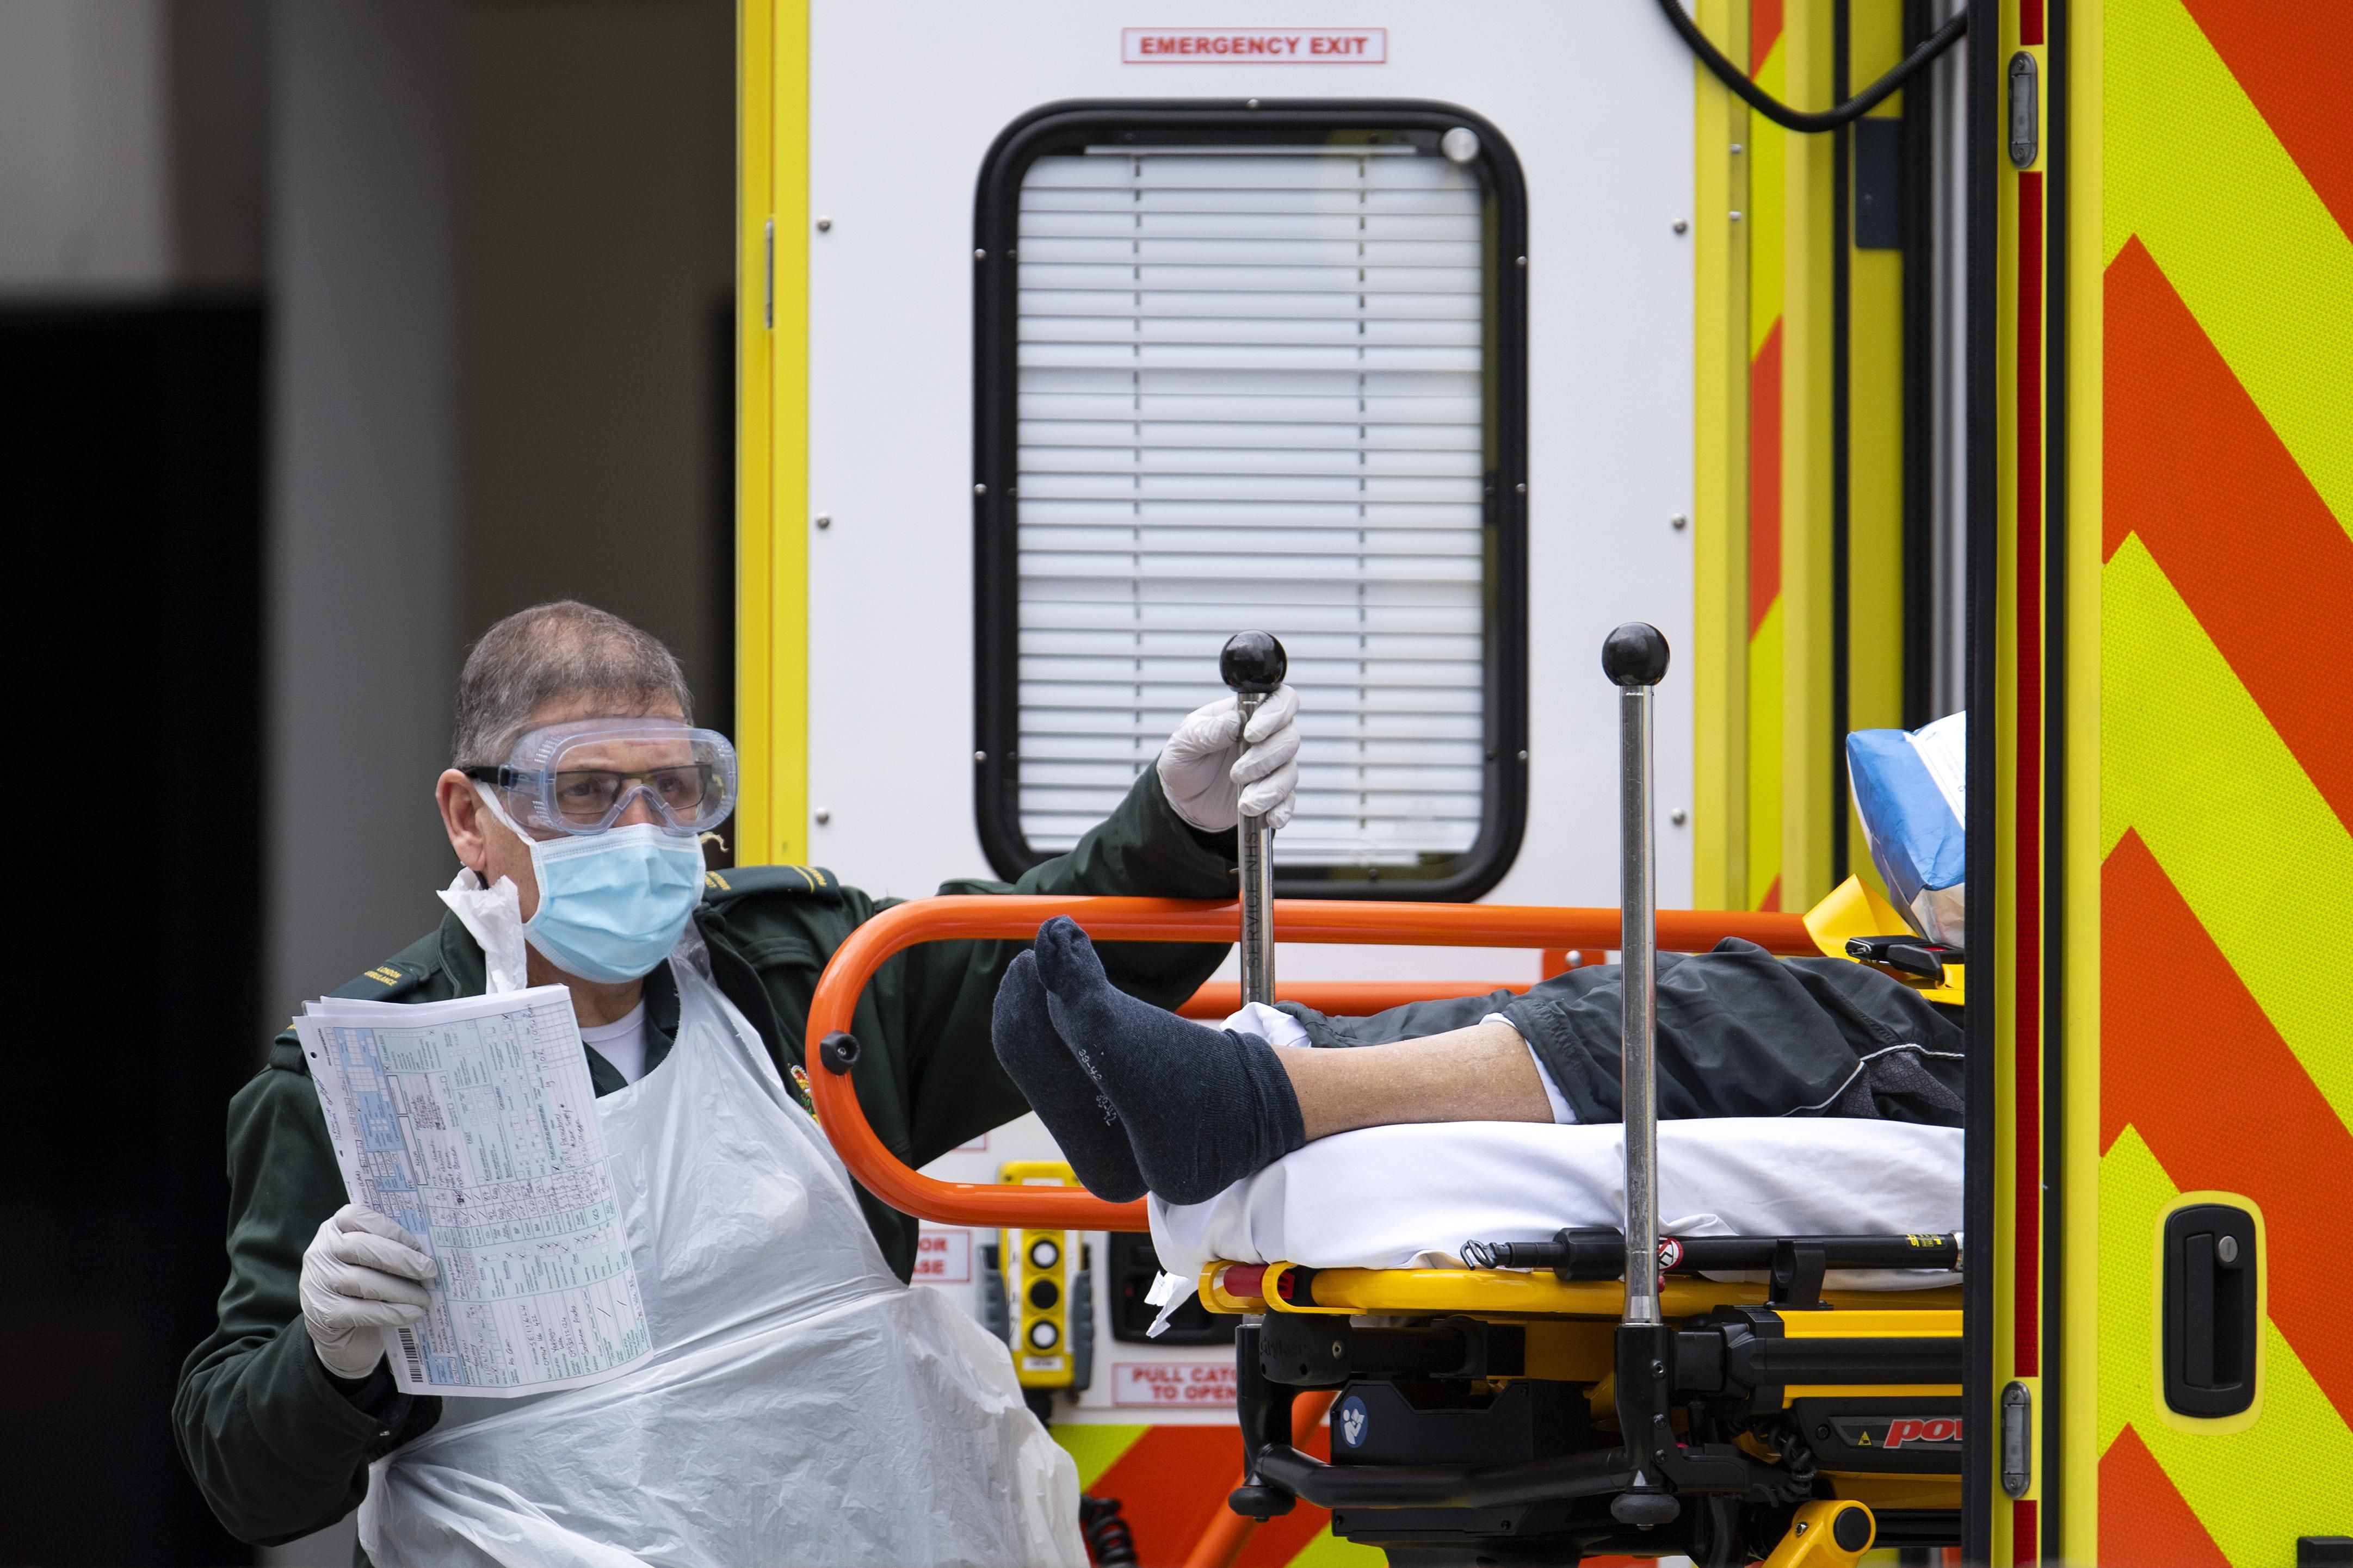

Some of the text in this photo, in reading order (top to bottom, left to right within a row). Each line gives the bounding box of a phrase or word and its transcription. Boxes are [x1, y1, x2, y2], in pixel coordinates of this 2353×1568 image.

[1140, 36, 1368, 54] EMERGENCY EXIT
[1244, 831, 1259, 872] NHS
[1244, 882, 1260, 969] SERVICE
[364, 970, 398, 987] AMBULANCE
[376, 965, 402, 979] LONDON
[1132, 1367, 1183, 1383] PULL
[1152, 1385, 1236, 1399] TO OPEN
